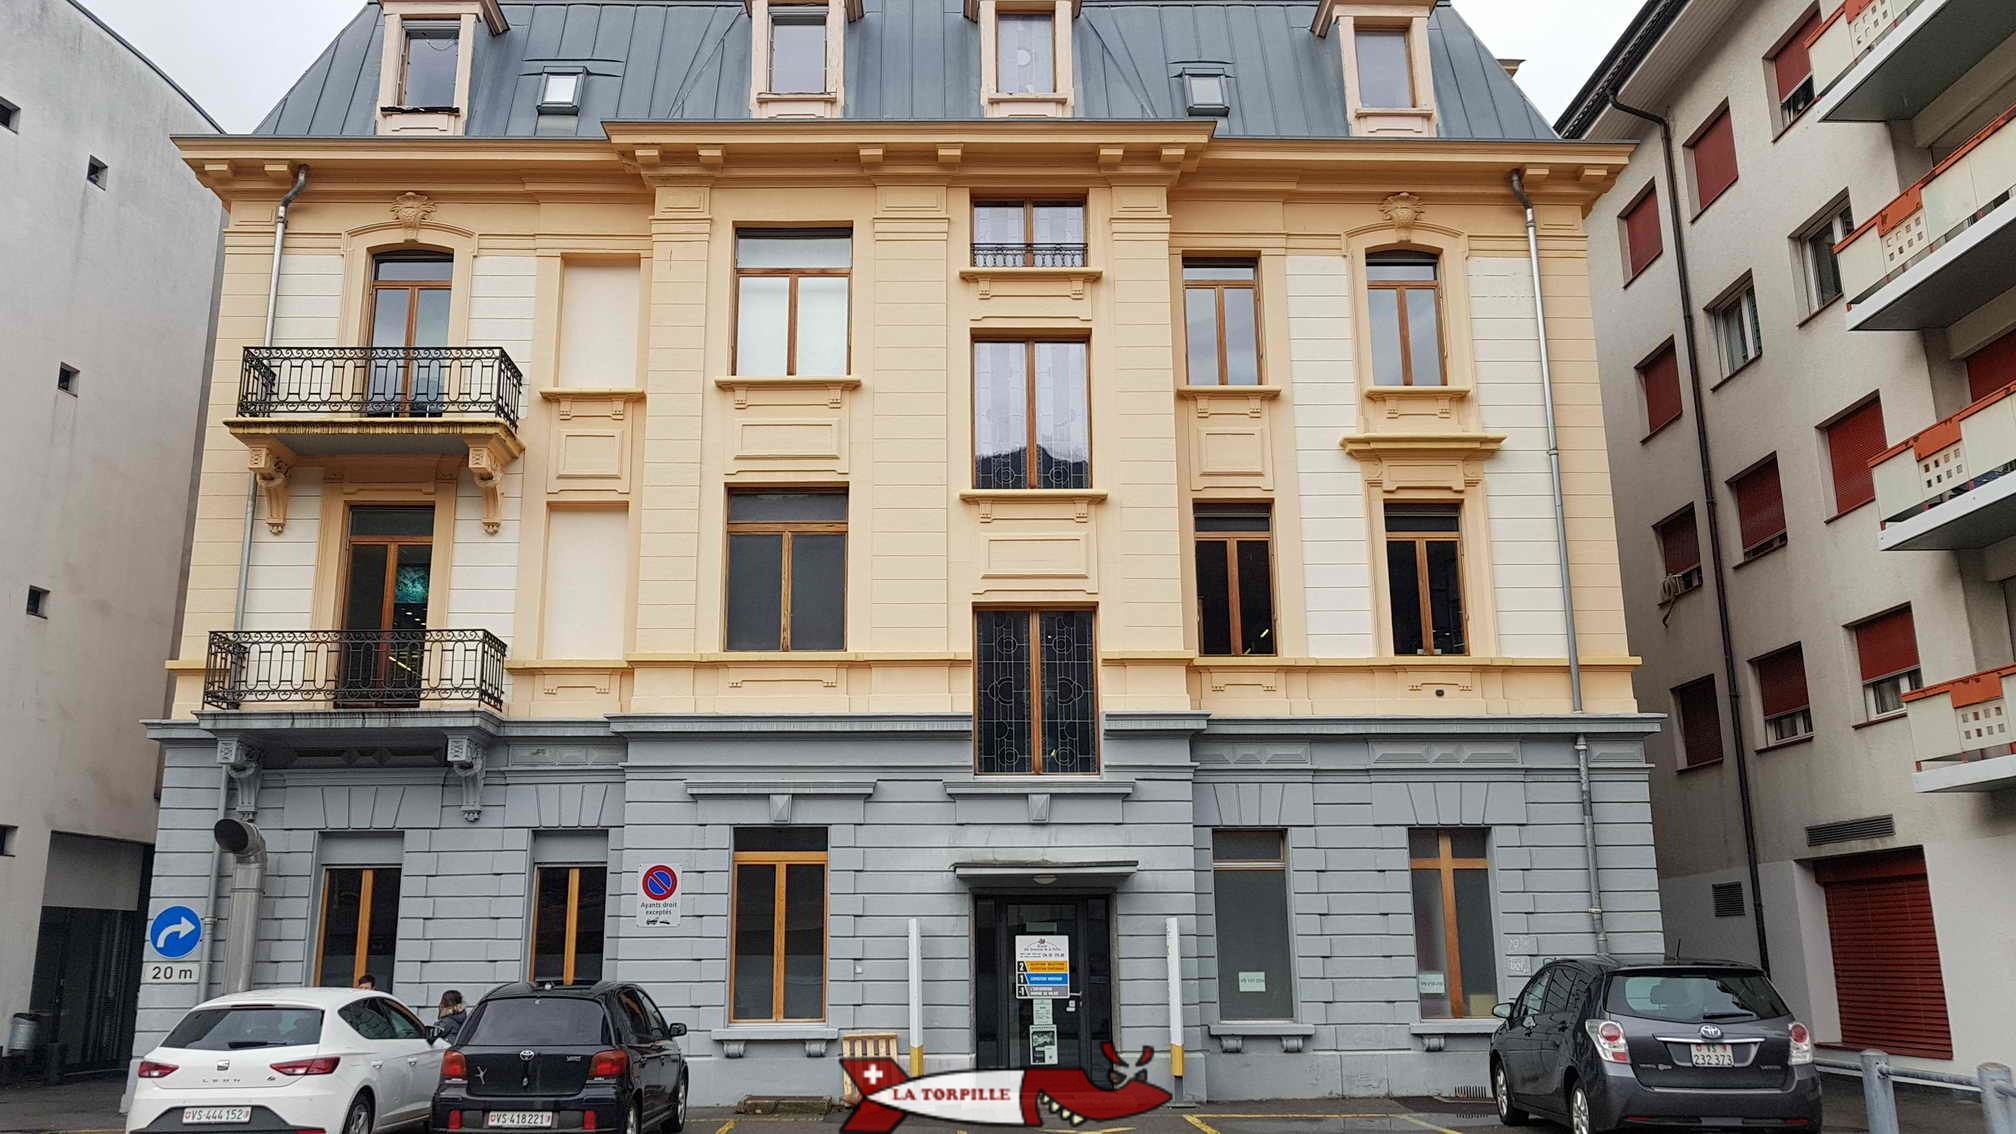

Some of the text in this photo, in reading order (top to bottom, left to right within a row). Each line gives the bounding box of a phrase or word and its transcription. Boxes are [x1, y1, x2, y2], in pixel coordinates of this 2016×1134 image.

[1019, 962, 1025, 971] 2
[152, 966, 193, 980] 20 m
